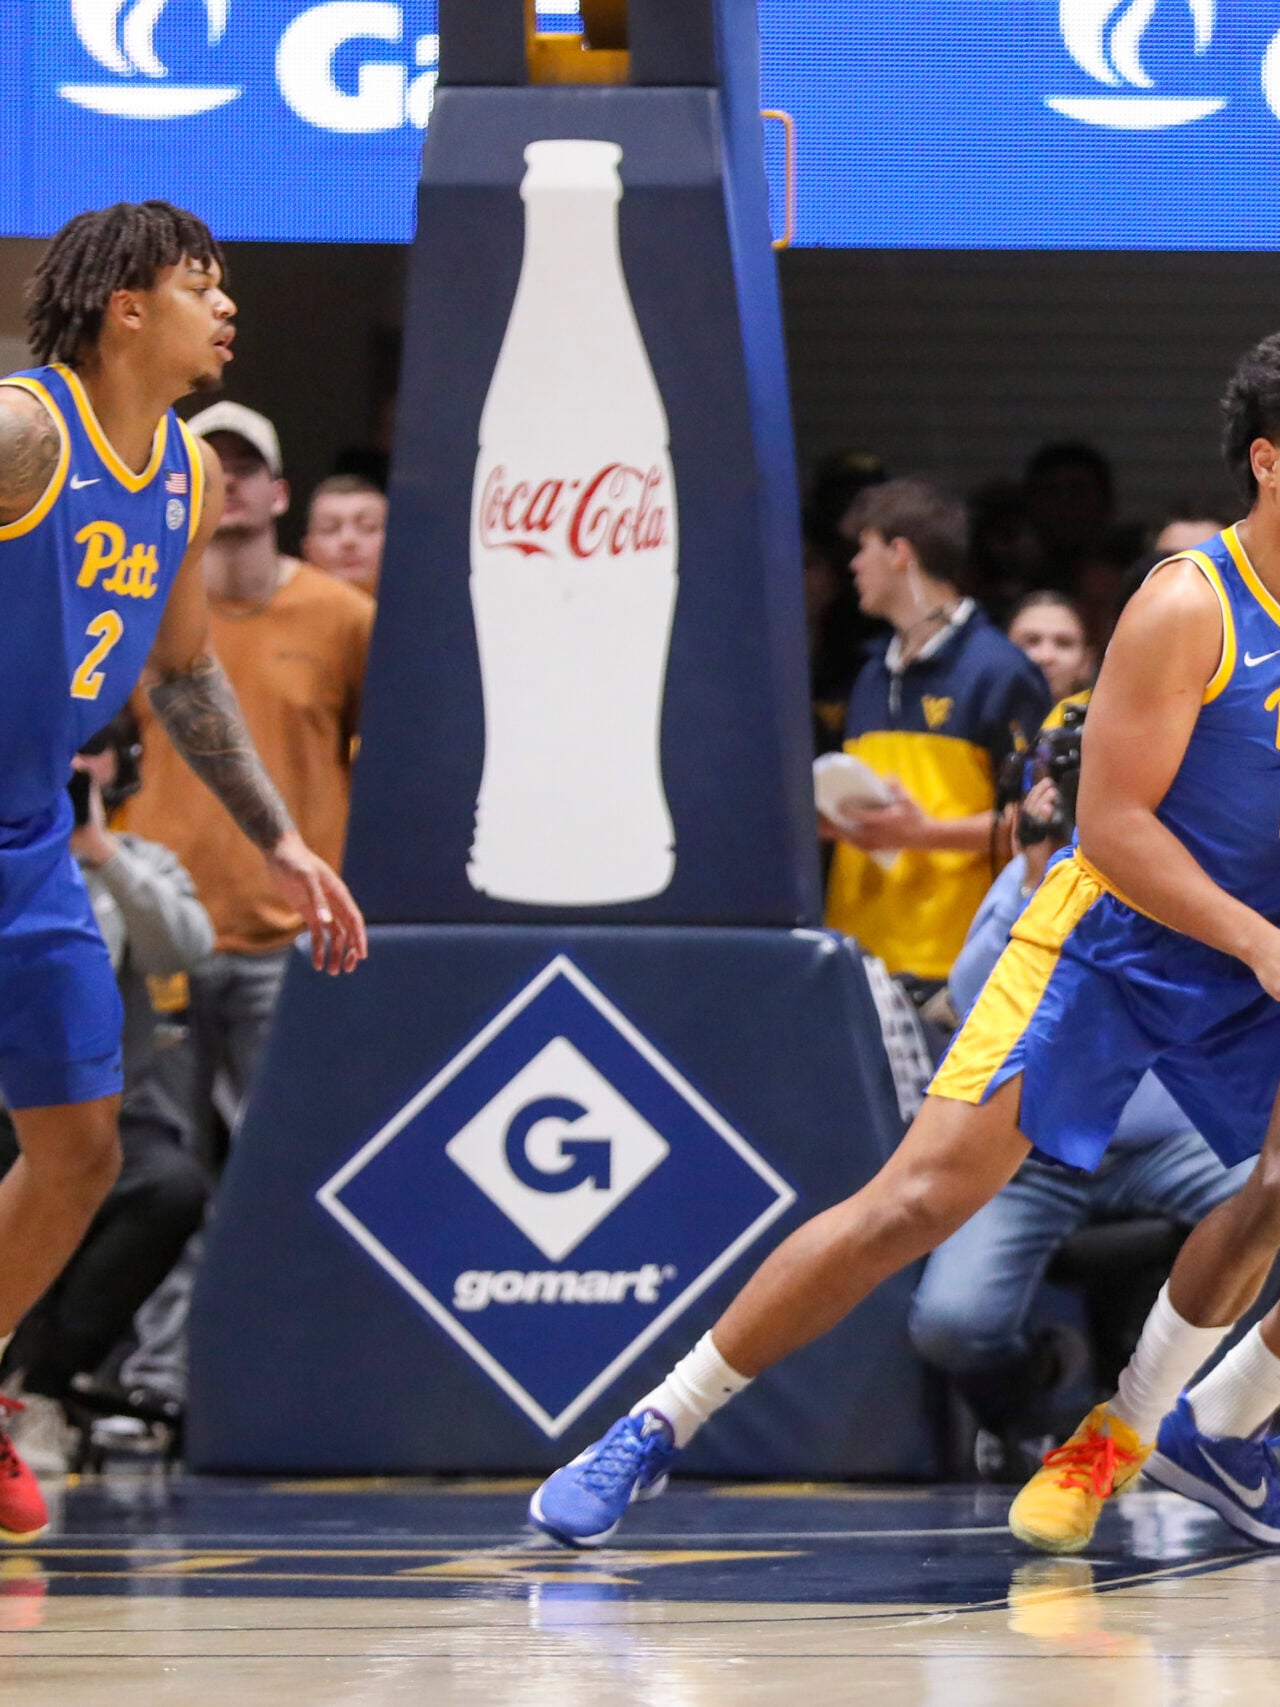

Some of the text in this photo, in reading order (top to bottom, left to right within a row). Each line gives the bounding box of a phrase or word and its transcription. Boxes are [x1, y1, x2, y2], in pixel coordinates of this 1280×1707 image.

[478, 462, 666, 558] Coca-Cola
[74, 520, 159, 599] Pitt
[70, 609, 124, 700] 2
